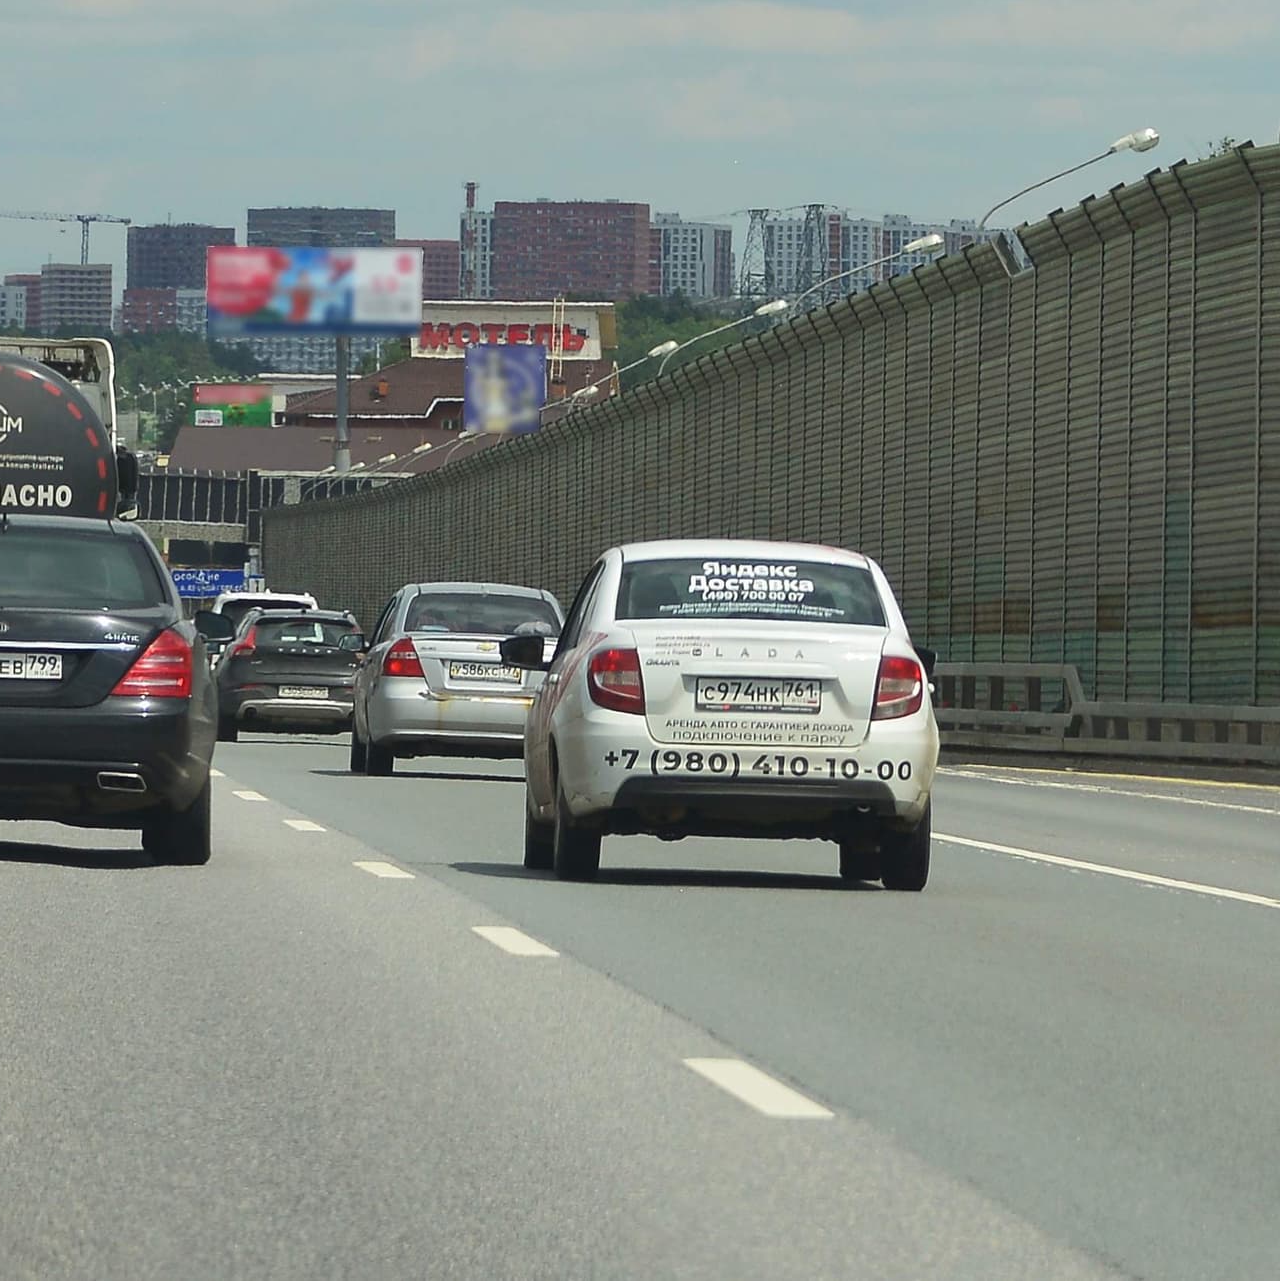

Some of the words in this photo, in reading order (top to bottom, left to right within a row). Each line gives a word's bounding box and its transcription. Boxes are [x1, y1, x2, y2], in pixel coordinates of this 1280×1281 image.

[420, 322, 586, 351] МОТЕЛЬ
[702, 561, 798, 578] Яндекс
[688, 575, 814, 593] Доставка
[740, 590, 766, 601] 700
[715, 647, 804, 659] LADA
[27, 654, 58, 672] 799
[704, 681, 780, 703] С974НК
[785, 682, 814, 699] 761
[666, 720, 707, 729] АРЕНДА
[710, 721, 738, 729] АВТО
[741, 721, 747, 729] С
[750, 721, 809, 731] ГАРАНТИЕЙ
[812, 723, 854, 733] ДОХОДА
[672, 730, 782, 742] подключение
[788, 733, 795, 741] к
[800, 733, 846, 745] парку
[604, 749, 640, 769] +7
[650, 749, 741, 778] (980)
[752, 754, 913, 780] 410-10-00
